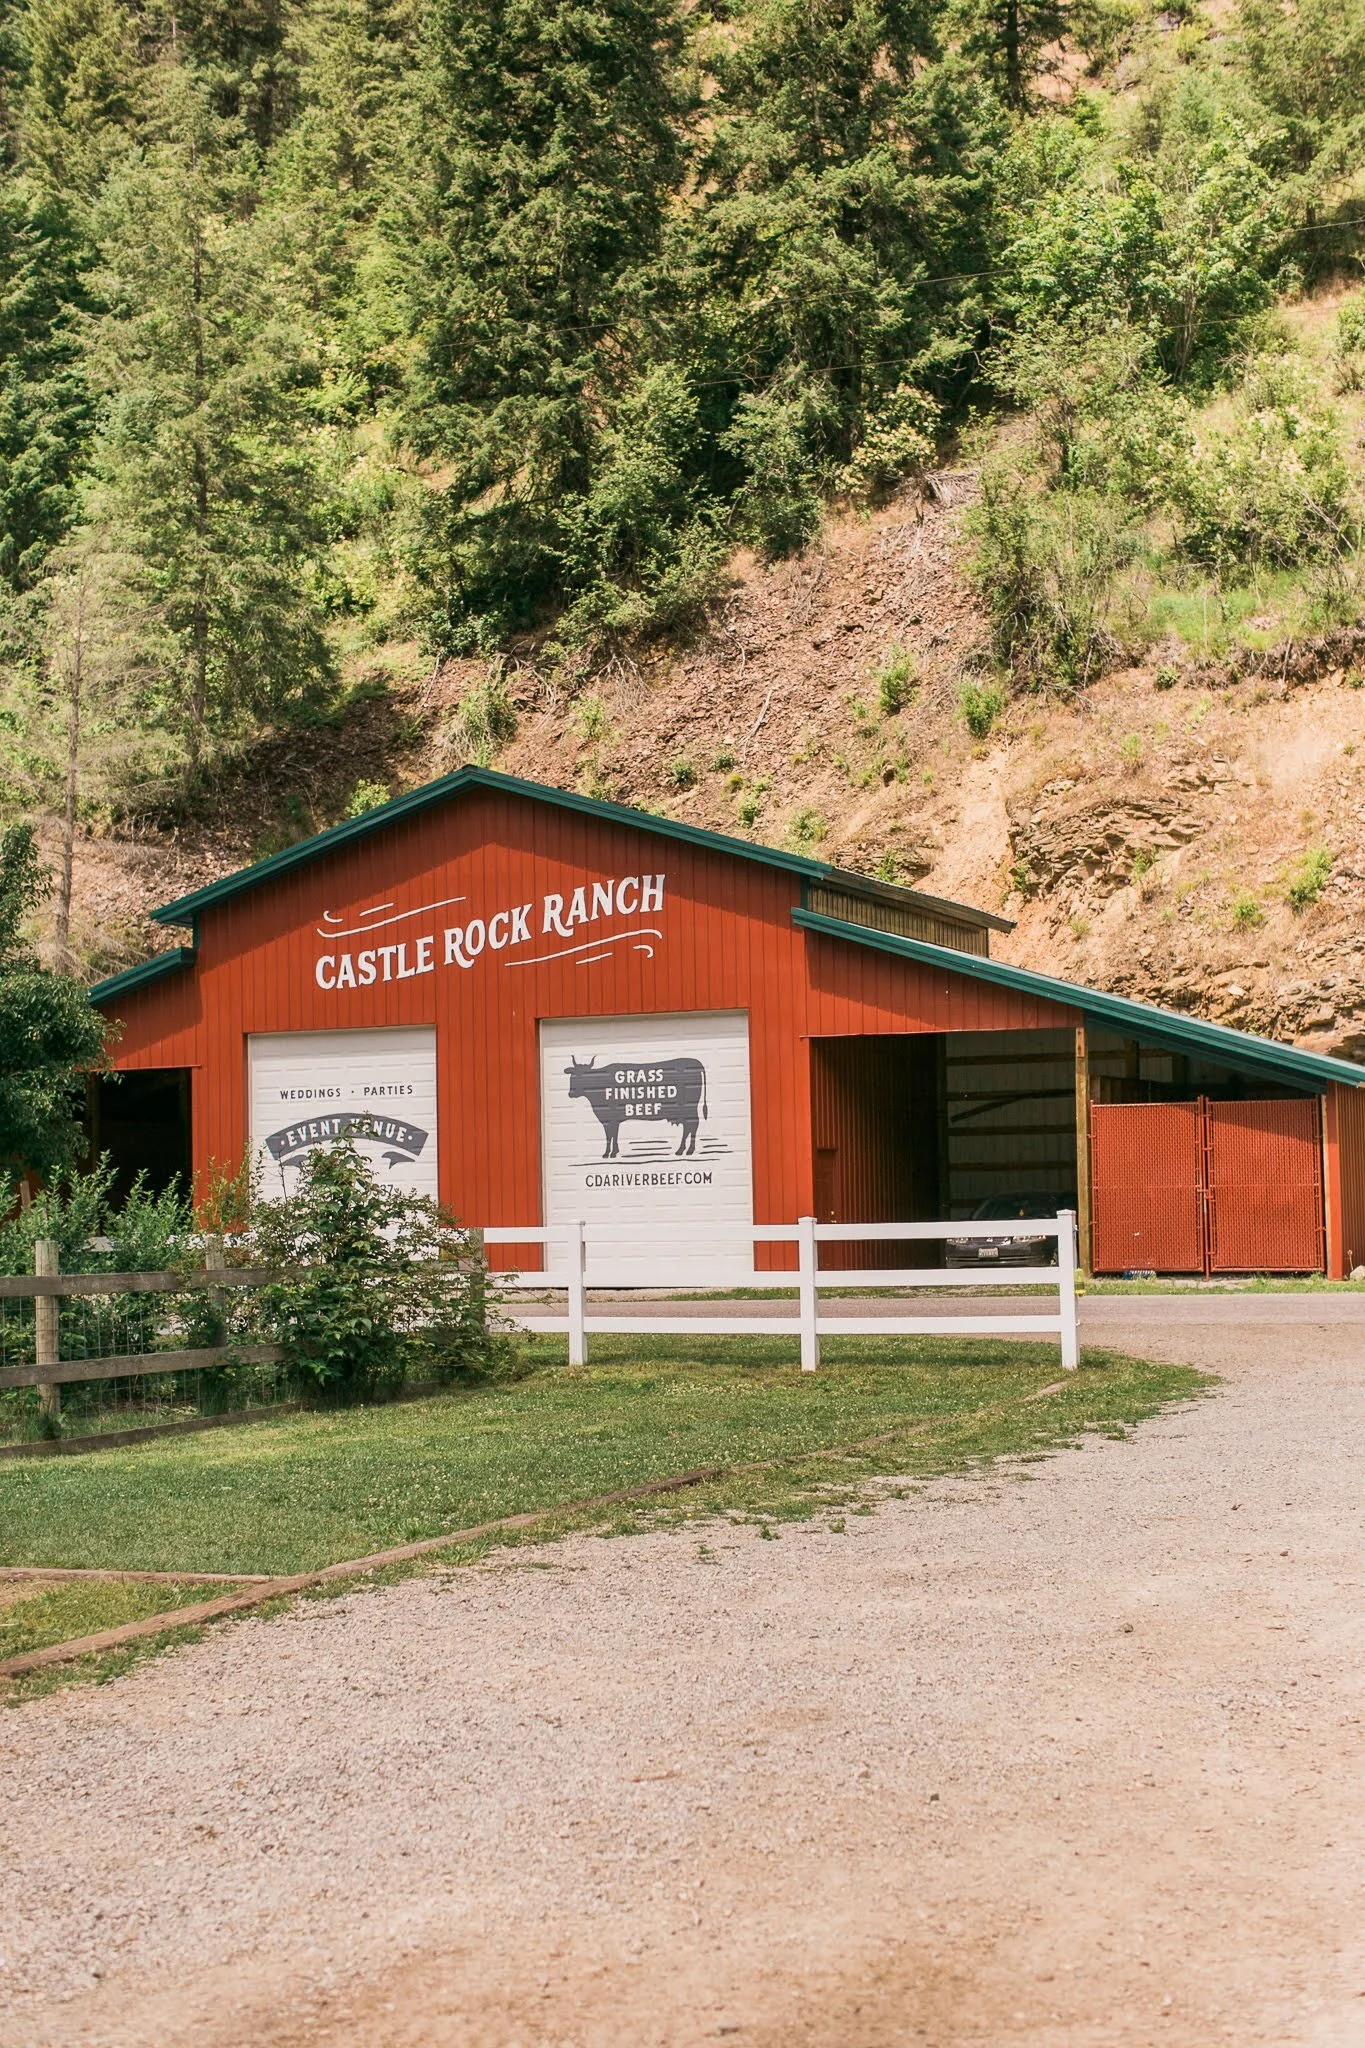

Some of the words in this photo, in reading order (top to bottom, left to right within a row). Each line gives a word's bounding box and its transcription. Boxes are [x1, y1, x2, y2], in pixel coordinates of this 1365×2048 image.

[315, 935, 434, 990] CASTLE
[443, 903, 533, 968] ROCK
[541, 873, 666, 937] RANCH
[614, 1069, 664, 1084] GRASS
[280, 1088, 341, 1100] WEDDINGS
[363, 1085, 414, 1096] PARTIES
[605, 1085, 678, 1100] FINISHED
[625, 1103, 662, 1117] BEEF
[286, 1118, 341, 1147] EVENT
[585, 1171, 713, 1188] CDARIVERBEEF.COM
